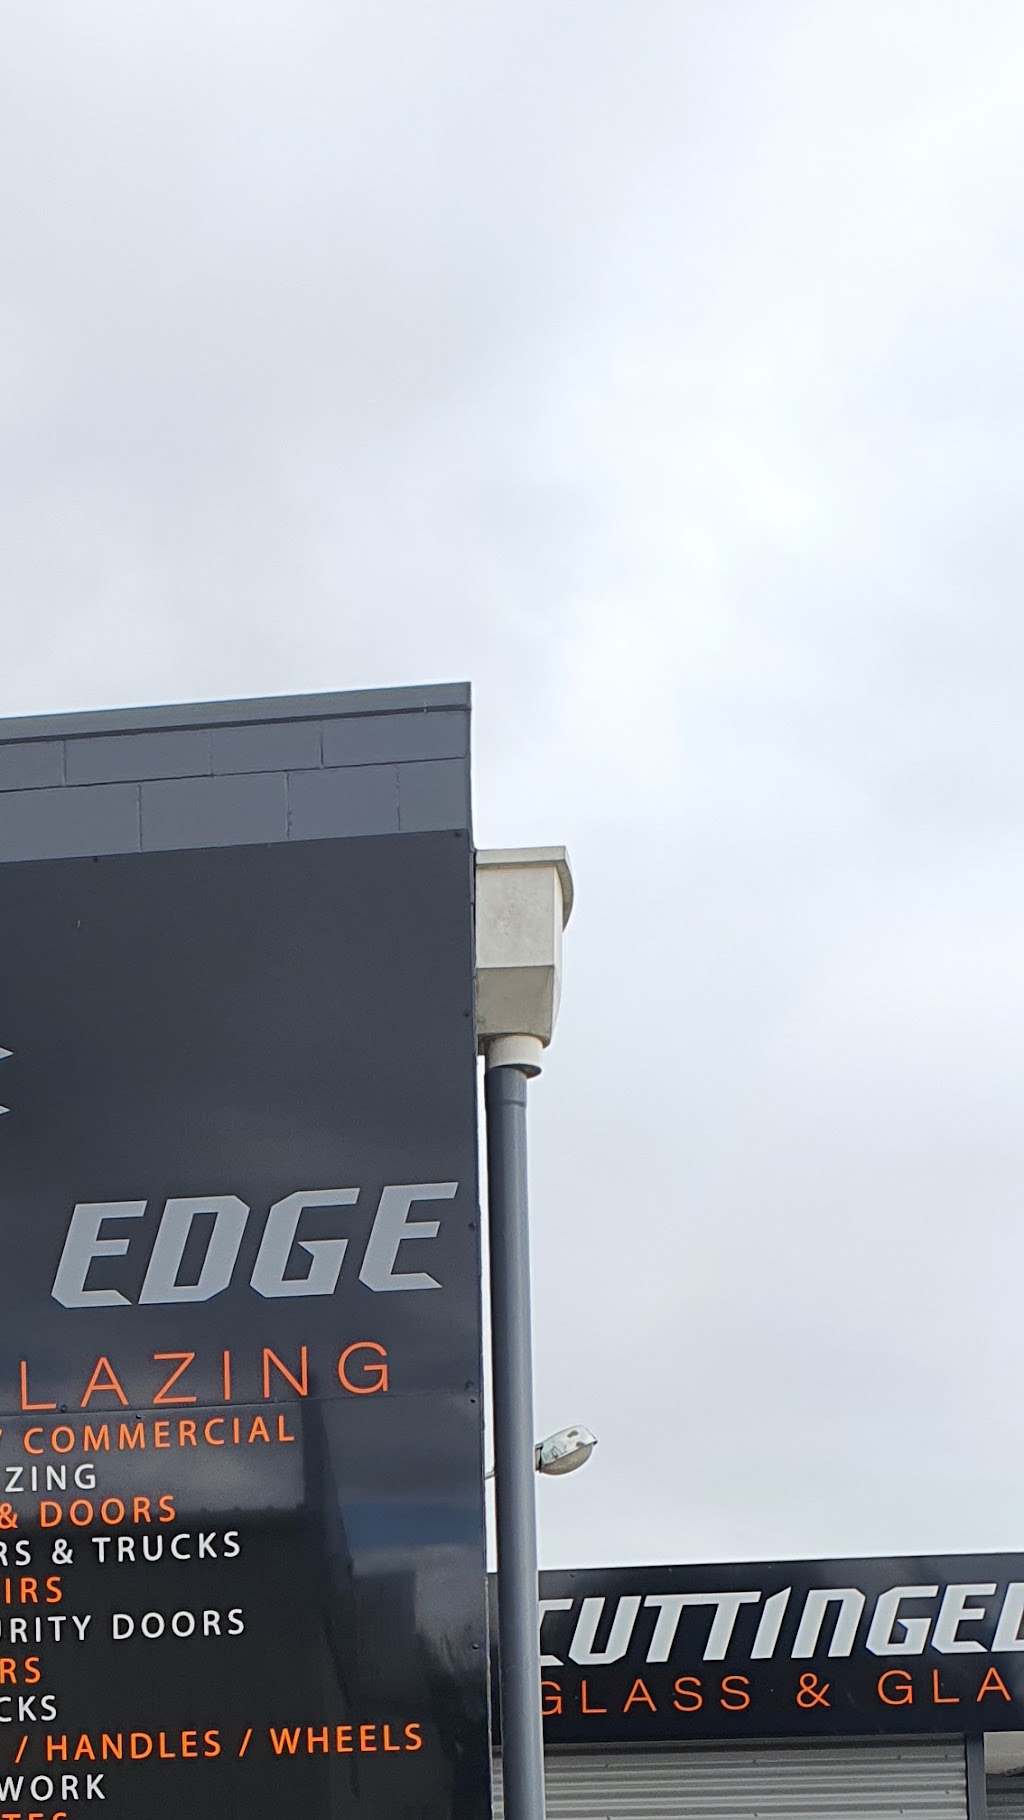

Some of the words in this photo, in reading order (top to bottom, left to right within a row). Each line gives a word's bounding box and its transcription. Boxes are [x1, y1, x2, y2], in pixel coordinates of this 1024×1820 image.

[51, 1181, 459, 1308] EDGE
[22, 1415, 294, 1456] COMMERCIAL
[38, 1494, 176, 1529] DOORS
[51, 1538, 73, 1565] &
[91, 1530, 240, 1563] TRUCKS
[112, 1608, 245, 1640] DOORS
[541, 1675, 751, 1716] GLASS
[796, 1672, 831, 1709] &
[877, 1666, 1012, 1705] GLA
[14, 1735, 29, 1764] /
[45, 1729, 222, 1763] HANDLES
[238, 1727, 253, 1758] /
[268, 1722, 423, 1756] WHEELS
